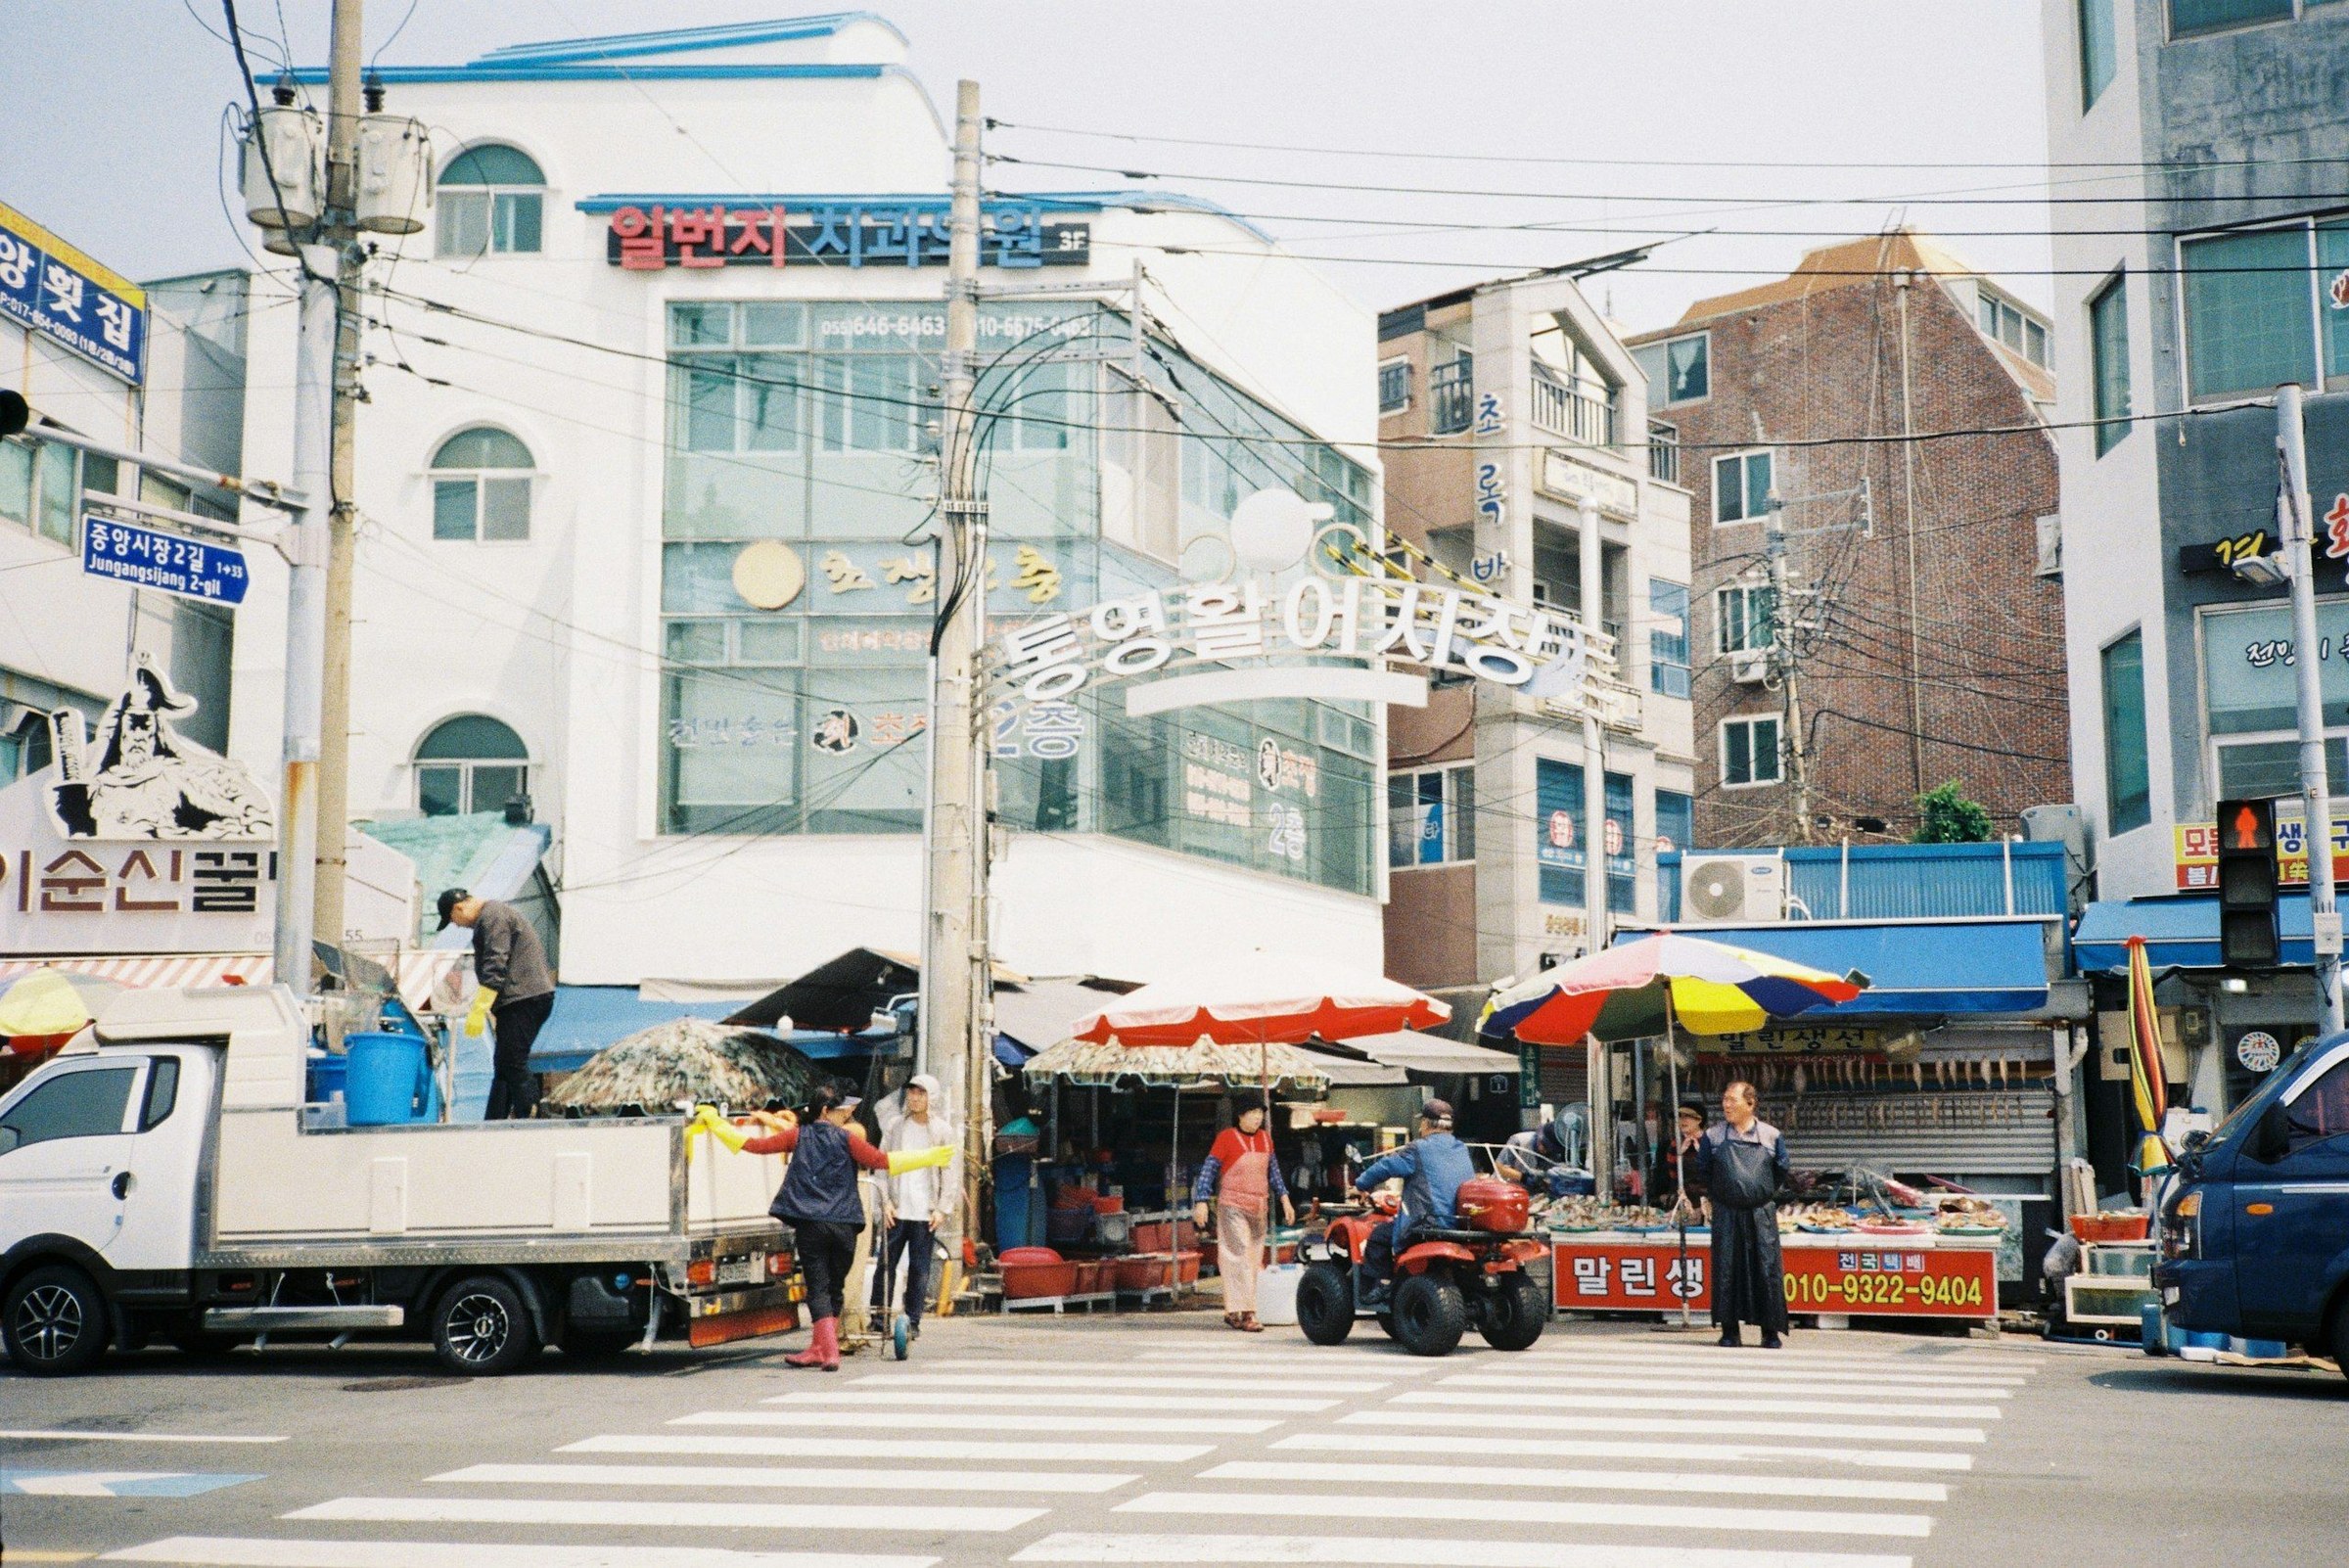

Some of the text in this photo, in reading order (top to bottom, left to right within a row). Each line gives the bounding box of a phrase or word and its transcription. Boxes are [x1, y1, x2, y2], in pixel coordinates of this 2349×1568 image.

[611, 205, 785, 269] 일번지
[1059, 230, 1087, 253] 3F
[89, 523, 205, 574] 중앙시장2길
[88, 554, 221, 597] Jungangsijang 2-gil
[1003, 576, 1548, 702] 통영활어시장
[1838, 1252, 1925, 1271] 전국택배
[1783, 1271, 1982, 1307] 010-9322-9404
